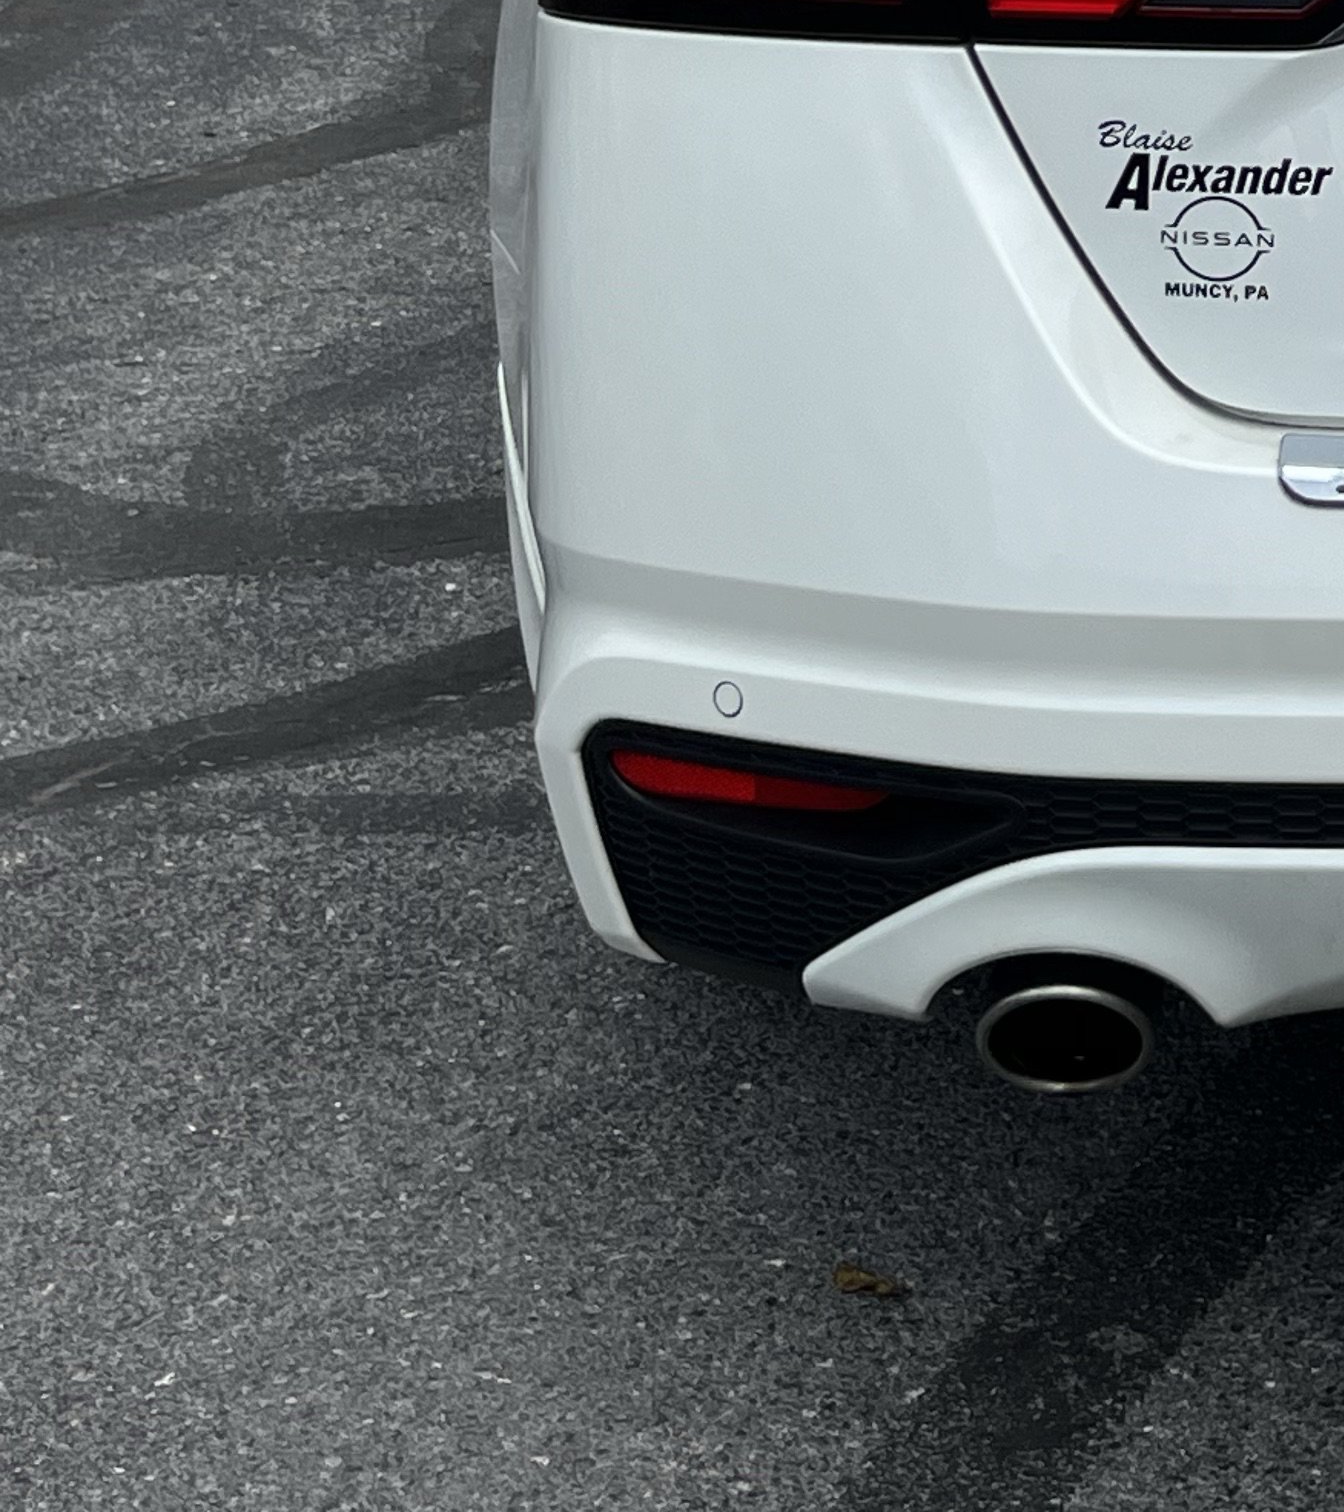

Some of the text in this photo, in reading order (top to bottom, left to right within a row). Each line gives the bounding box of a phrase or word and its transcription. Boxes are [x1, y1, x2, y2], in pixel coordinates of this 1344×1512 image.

[1098, 120, 1194, 151] Blaise
[1105, 152, 1334, 211] Alexander
[1160, 230, 1275, 248] NISSAN
[1164, 282, 1269, 303] MUNCY, PA
